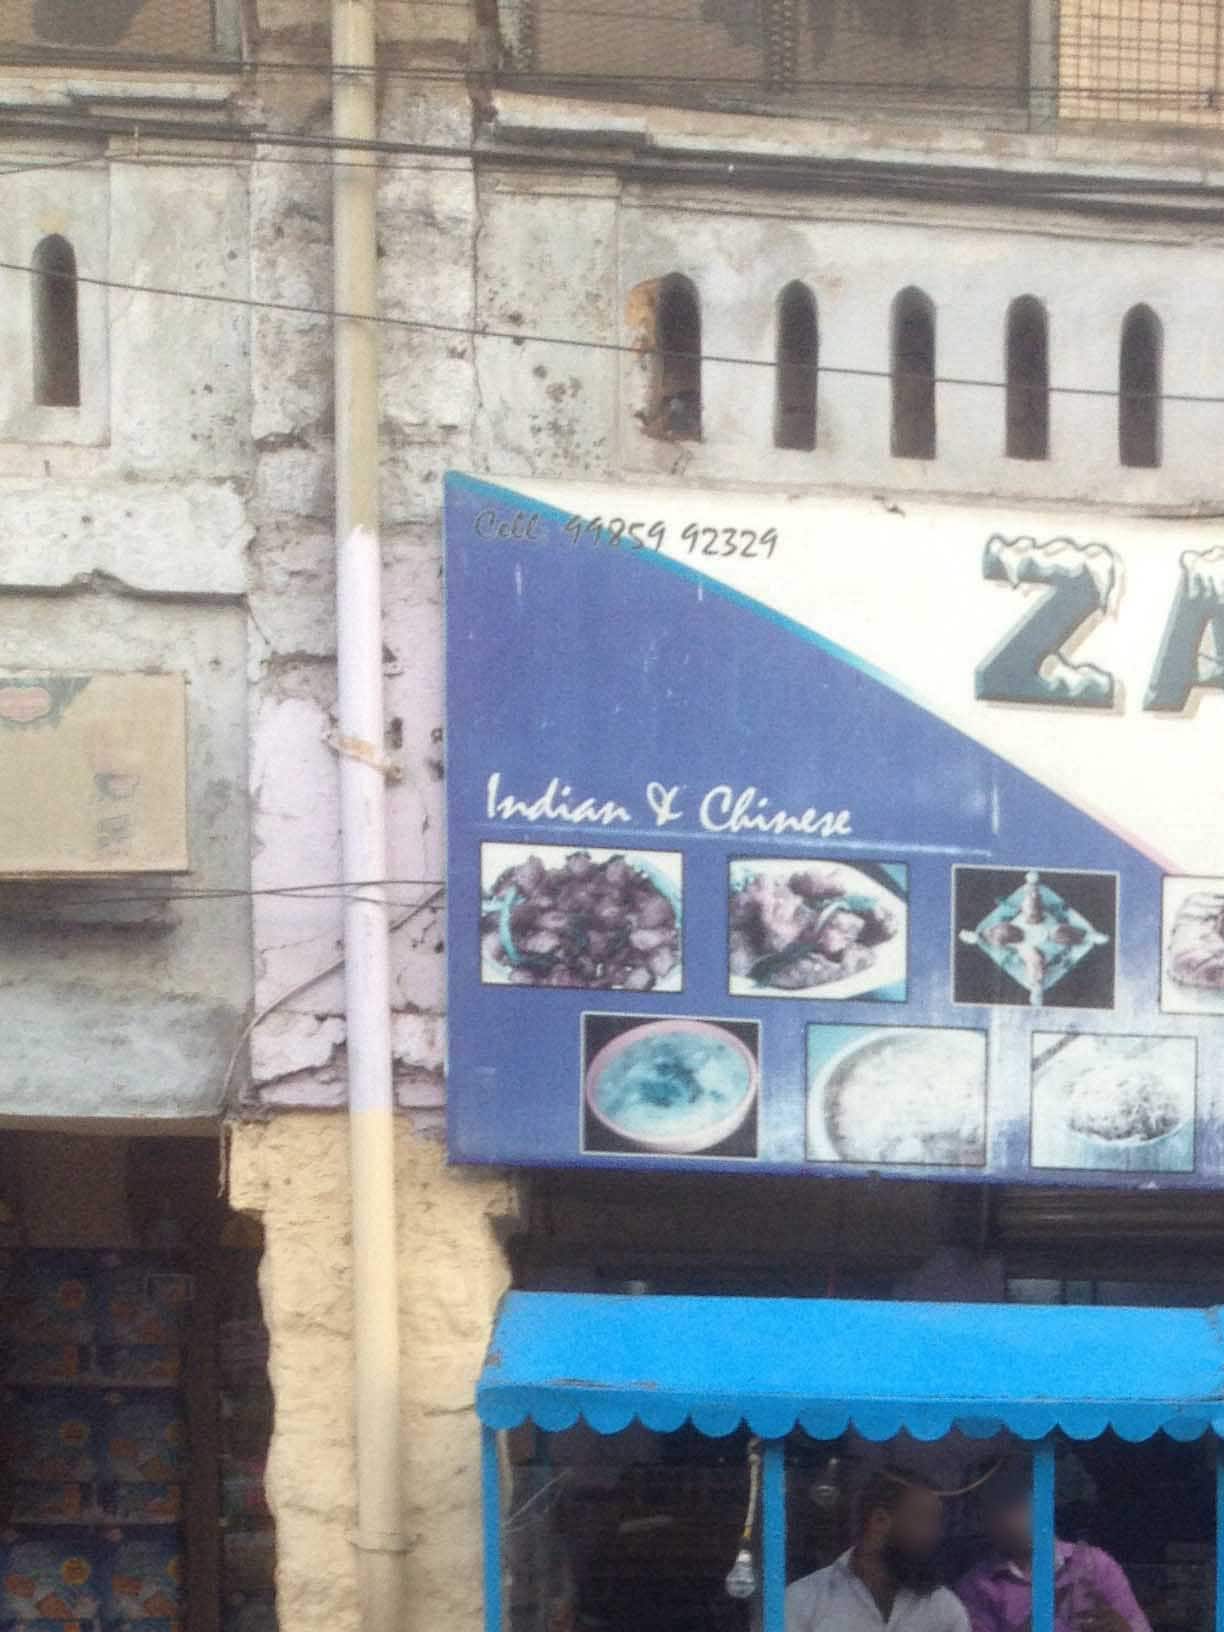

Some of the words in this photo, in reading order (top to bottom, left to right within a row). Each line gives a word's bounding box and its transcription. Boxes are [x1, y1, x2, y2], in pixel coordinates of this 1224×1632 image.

[473, 509, 541, 542] Cell
[563, 515, 667, 552] 99859
[680, 522, 779, 558] 92329
[485, 771, 631, 826] Indian
[644, 780, 684, 827] &
[699, 785, 854, 838] Chinese
